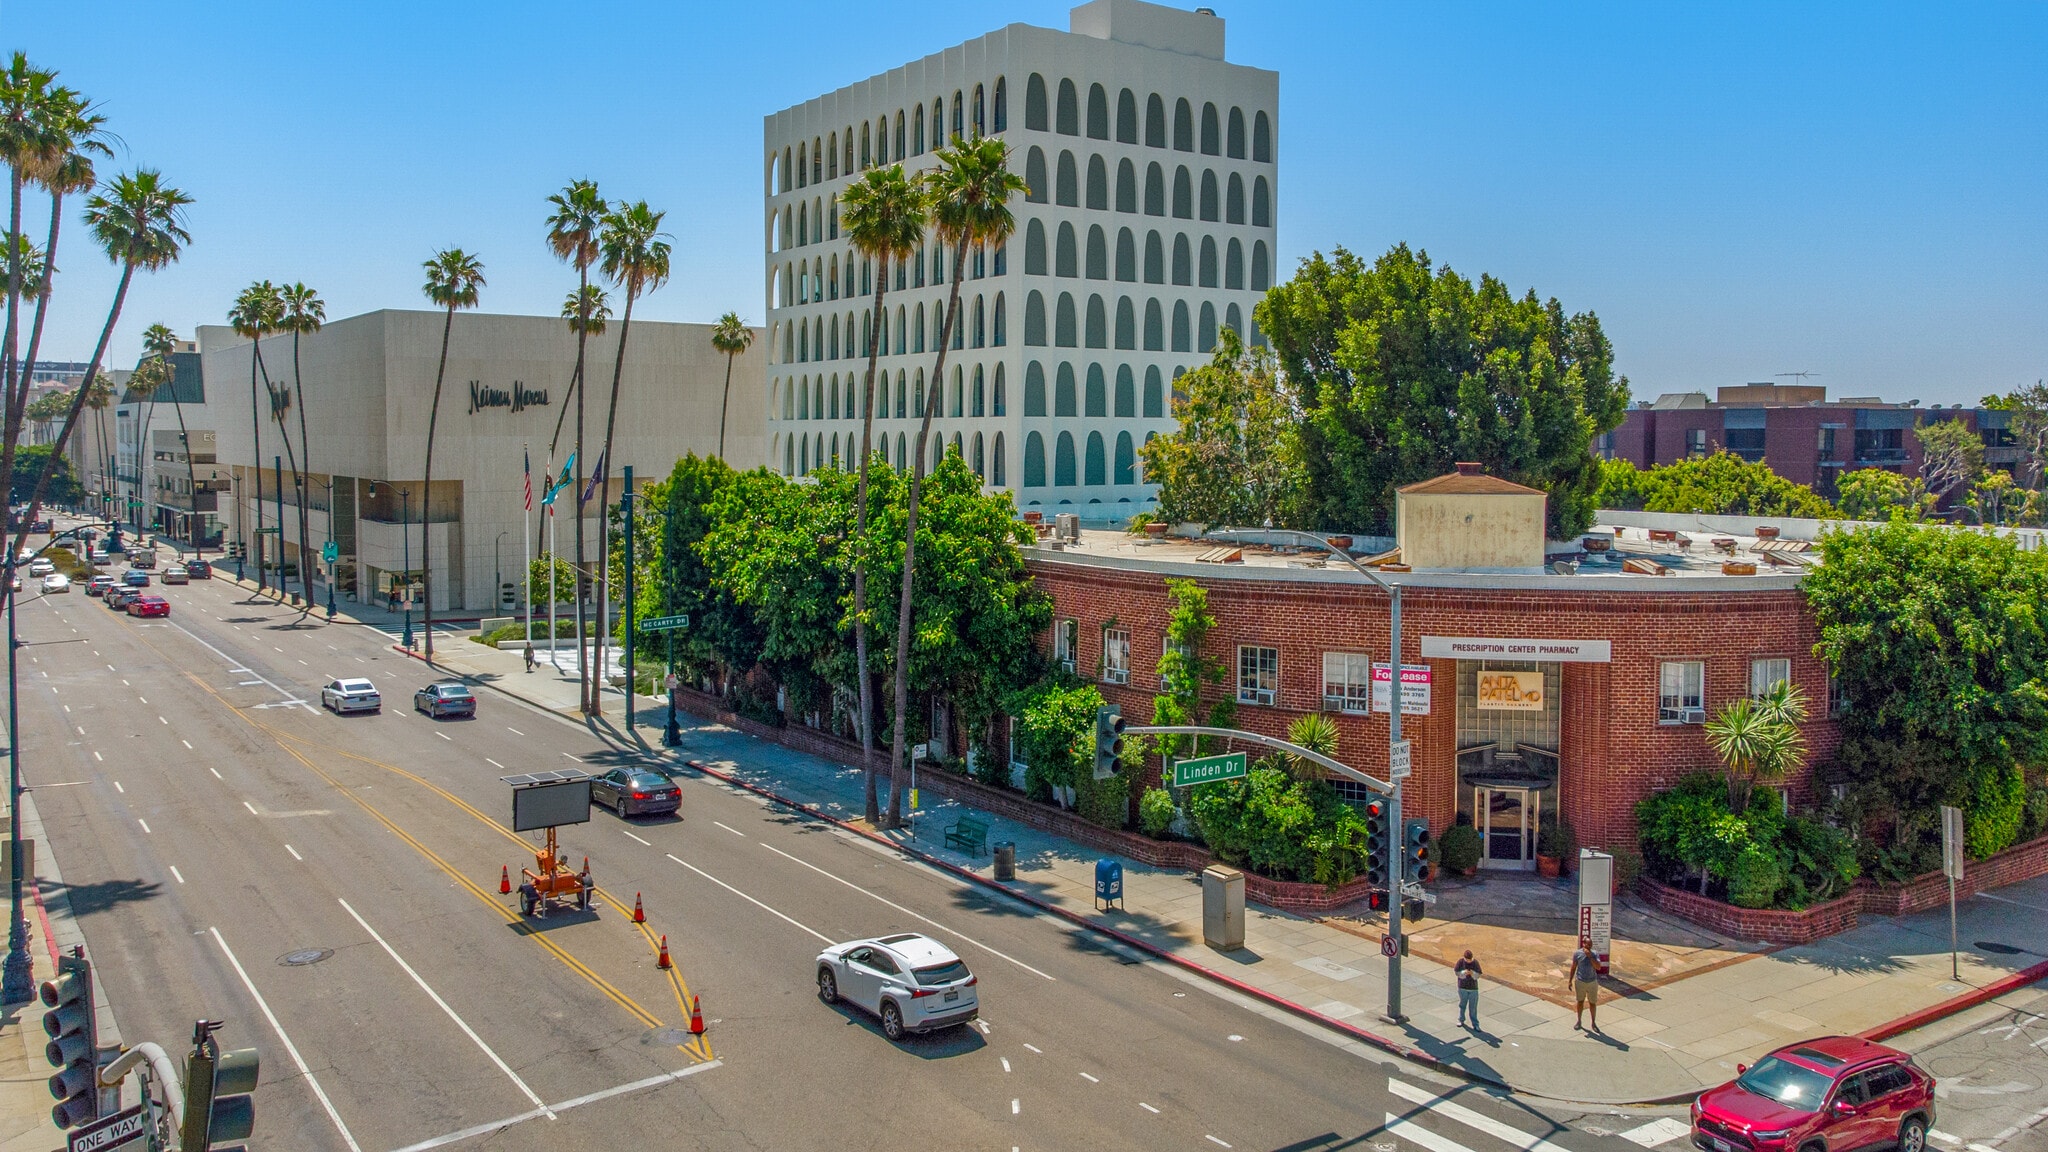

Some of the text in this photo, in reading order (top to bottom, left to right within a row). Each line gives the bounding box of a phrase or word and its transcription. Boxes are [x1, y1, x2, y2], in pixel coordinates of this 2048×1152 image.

[468, 380, 552, 415] Neiman Marcus
[1452, 643, 1579, 654] PRESCRIPTION CENTER PHARMACY
[1400, 672, 1428, 681] ease
[1480, 675, 1520, 690] ANITA
[1392, 744, 1409, 756] DO NOT
[1392, 757, 1409, 768] BLOCK
[1183, 760, 1239, 780] Linden Dr
[77, 1116, 138, 1152] ONE WAY
